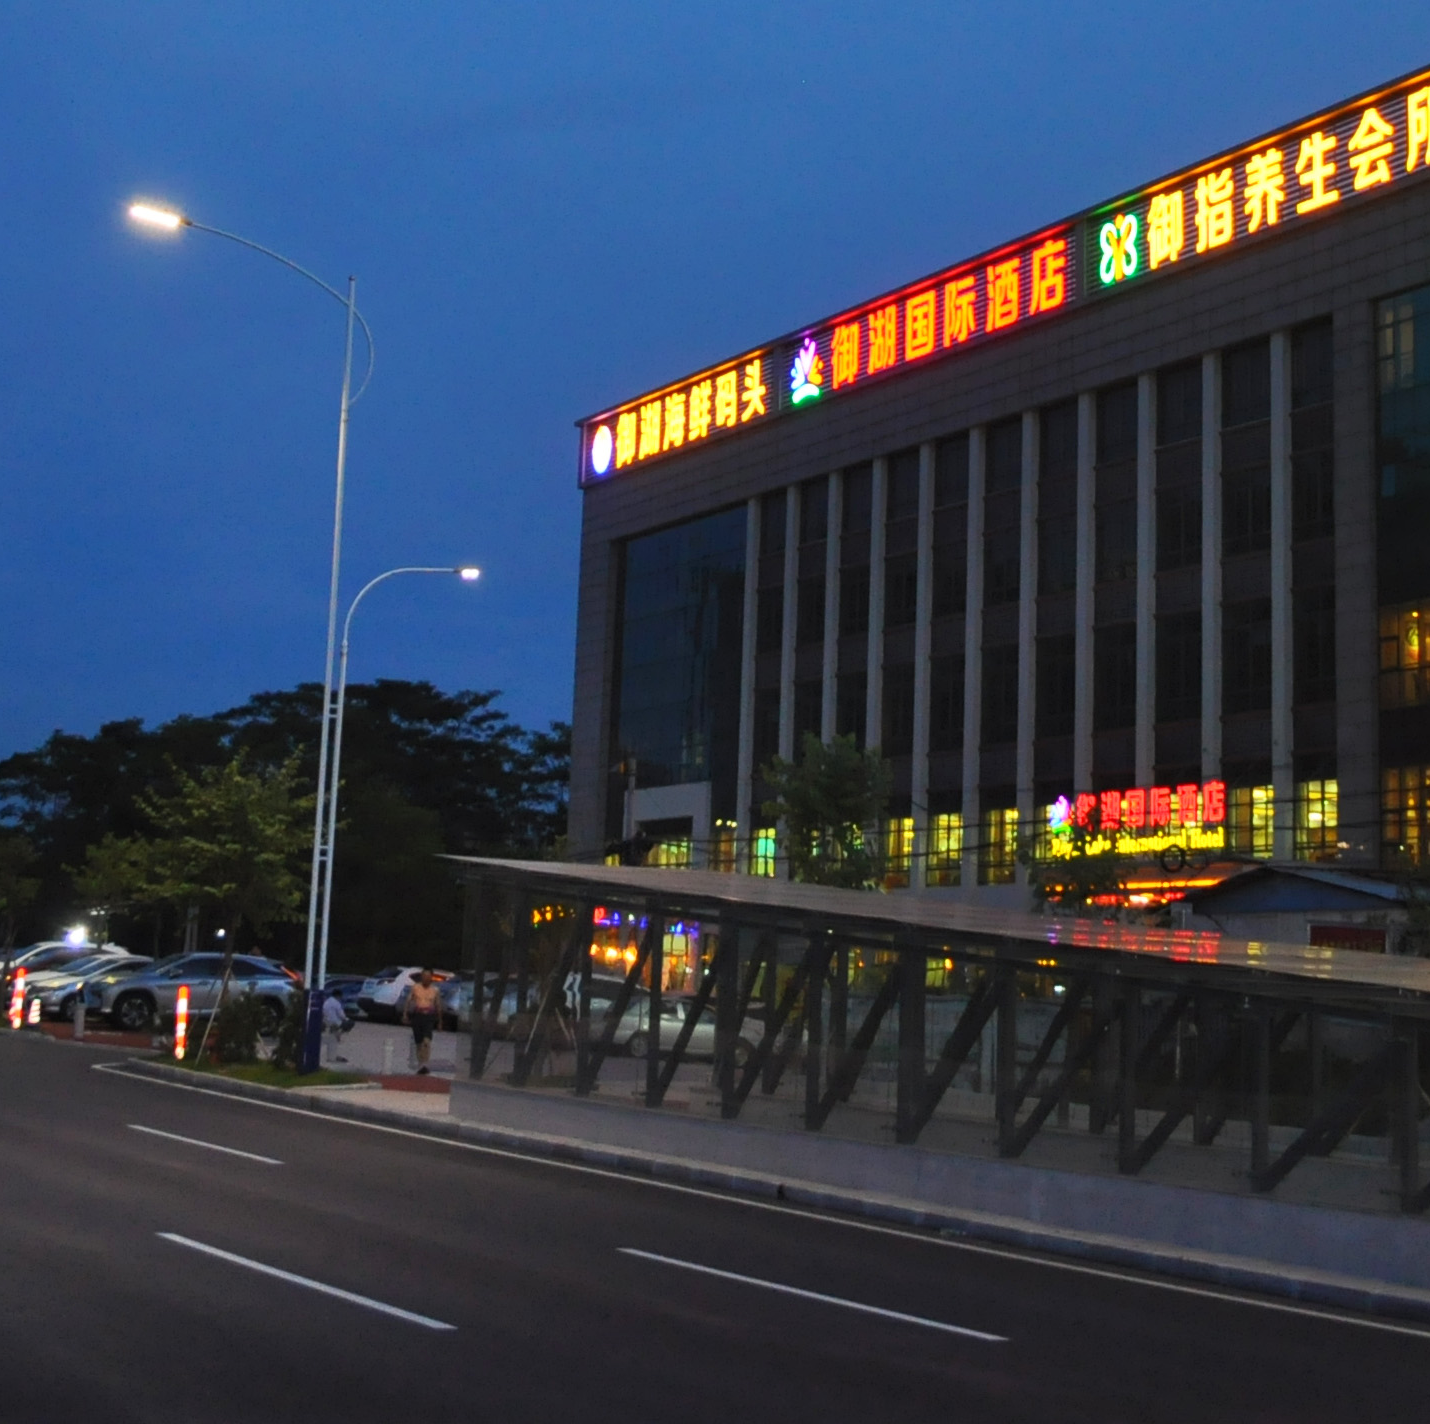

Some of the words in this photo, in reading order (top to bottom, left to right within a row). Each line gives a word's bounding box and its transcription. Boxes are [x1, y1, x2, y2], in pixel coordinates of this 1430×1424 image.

[830, 238, 1069, 391] 御湖国际酒店
[615, 358, 767, 469] 御湖海鲜码头
